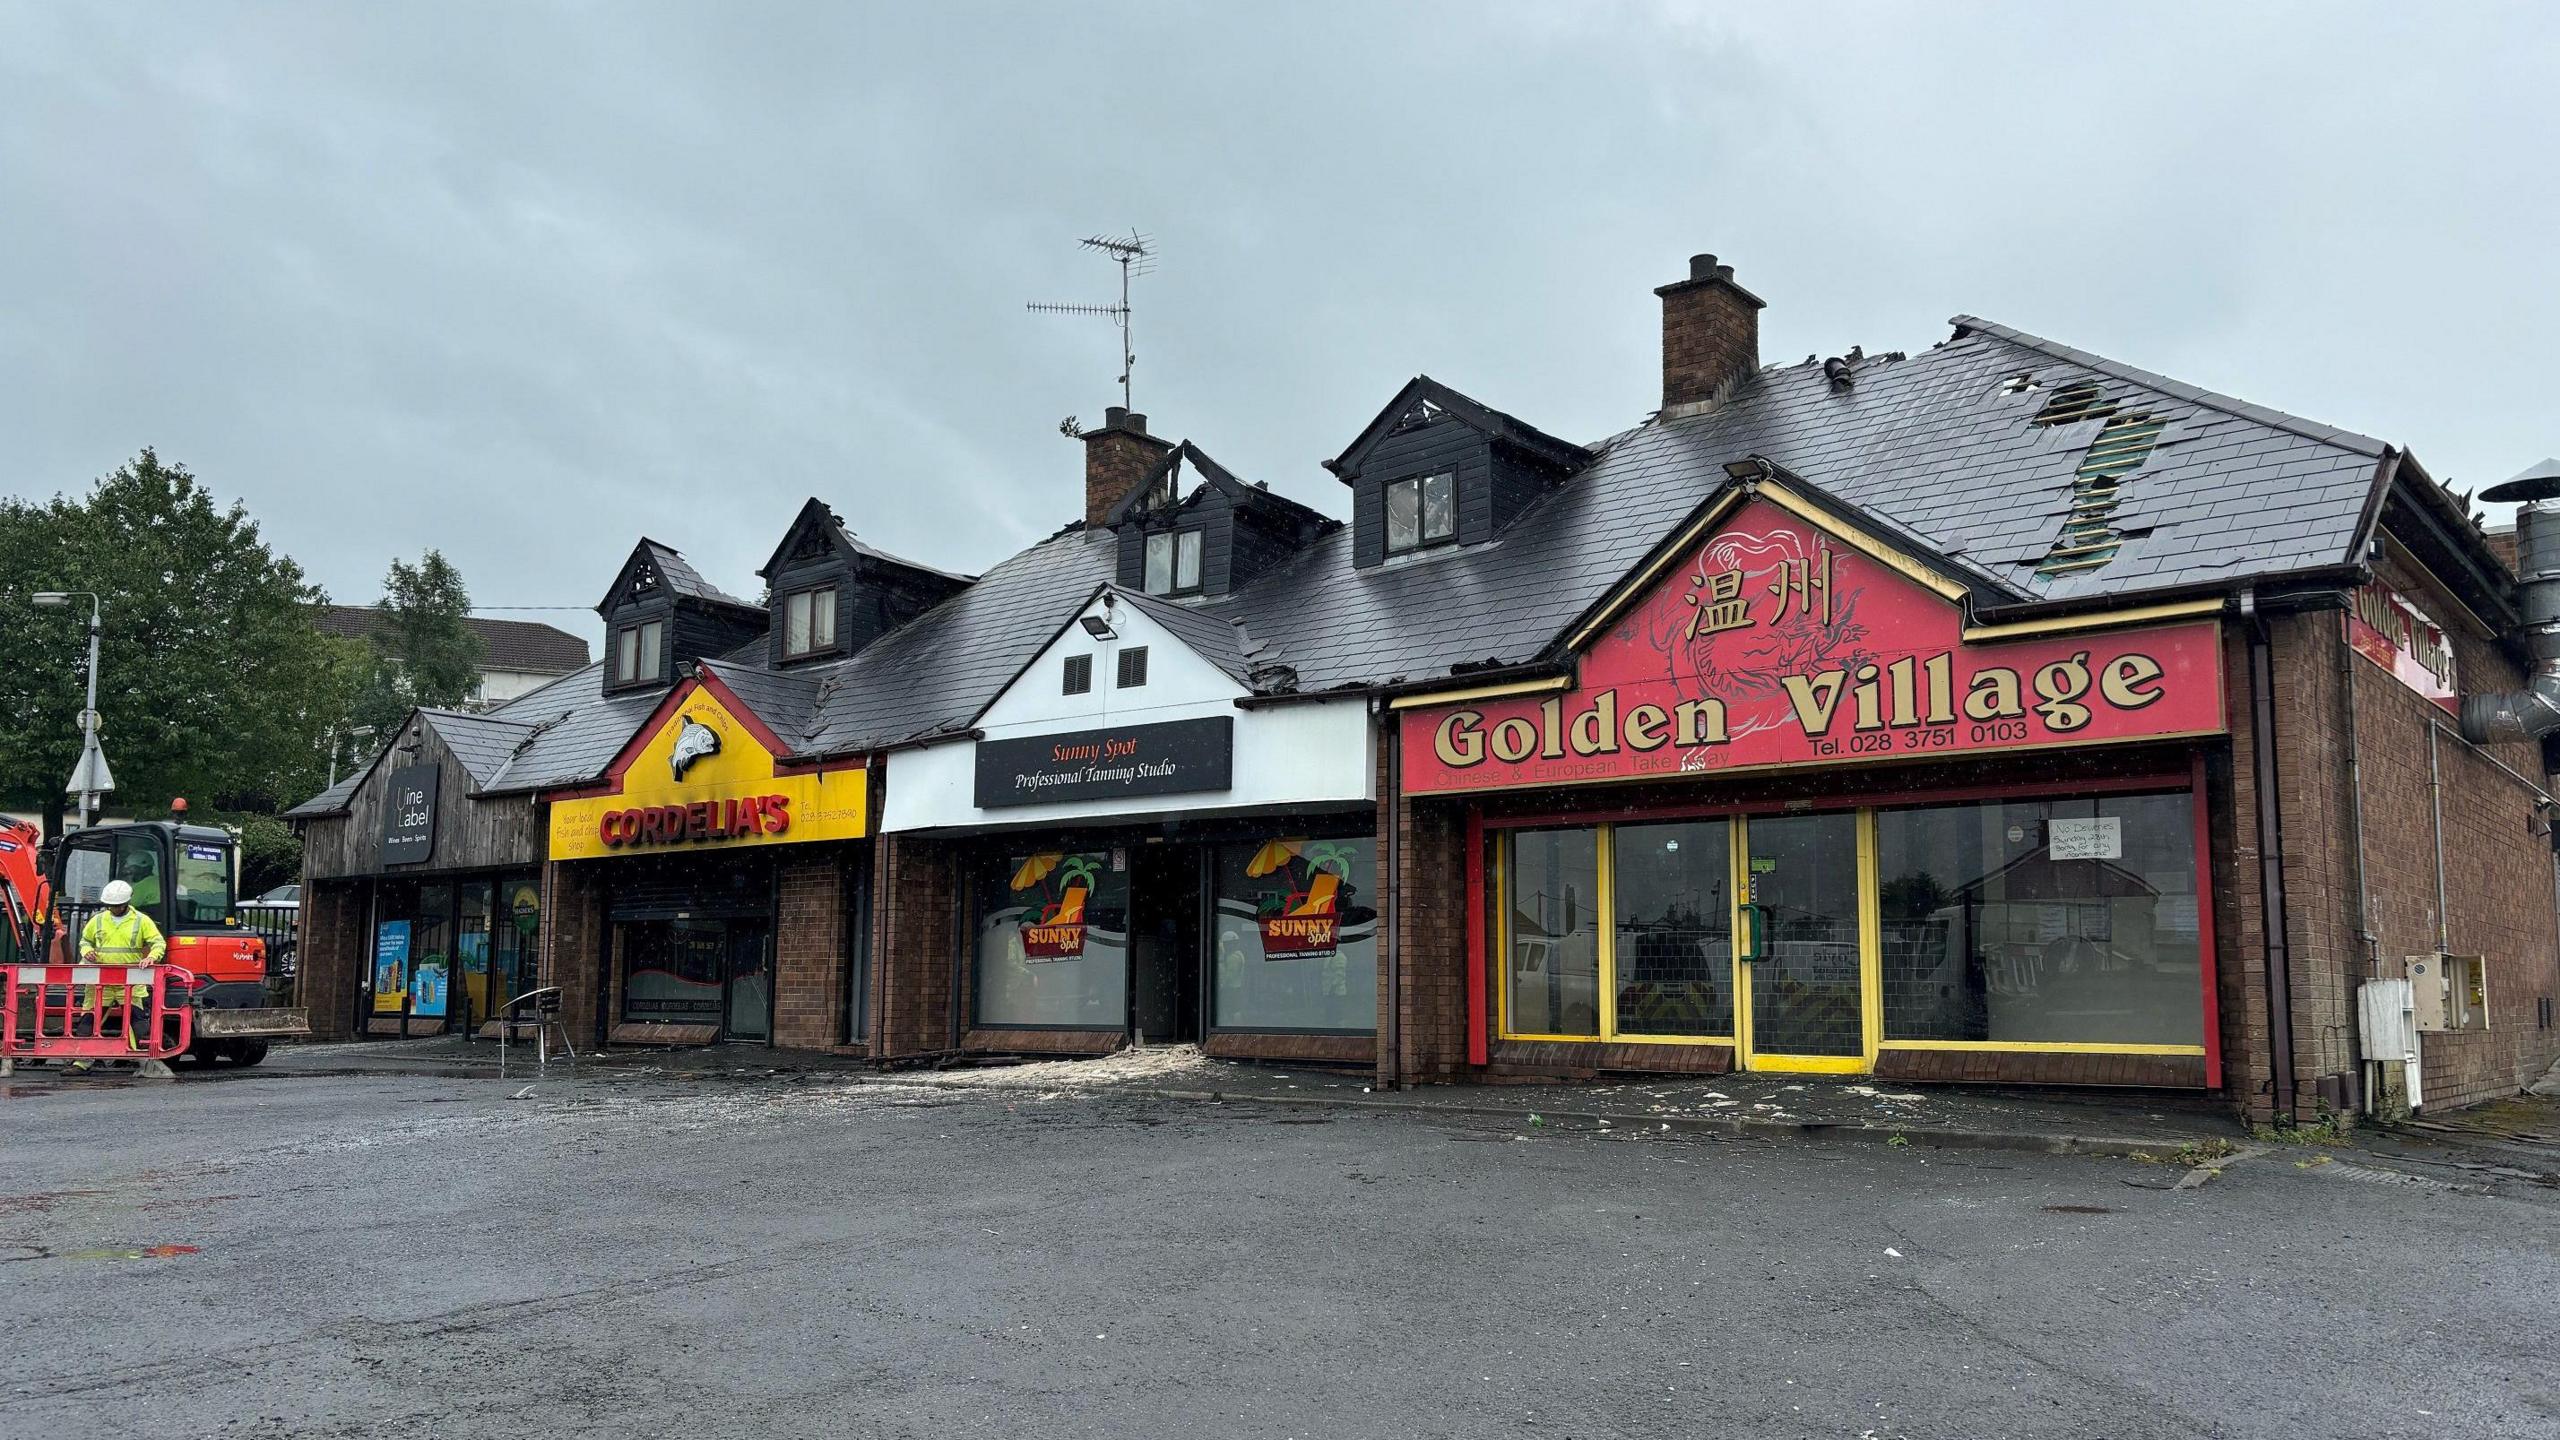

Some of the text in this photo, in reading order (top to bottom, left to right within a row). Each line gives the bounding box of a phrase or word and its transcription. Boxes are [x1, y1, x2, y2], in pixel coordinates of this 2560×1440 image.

[1684, 548, 1832, 641] 温州
[694, 703, 705, 711] Fish
[706, 705, 717, 715] and
[716, 711, 729, 732] Chips
[1434, 651, 2165, 769] Golden Village
[1052, 737, 1139, 764] Sunny Spot
[1809, 722, 2028, 756] Tel. 028 3751 0103
[1015, 758, 1176, 792] Professional Tanning Studio
[1435, 769, 1500, 786] Chinese
[1512, 766, 1524, 781] &
[1534, 759, 1617, 781] European
[1631, 754, 1672, 771] Take
[398, 804, 430, 828] Label
[600, 794, 791, 849] CORDELIA'S
[2056, 824, 2071, 834] No
[1029, 928, 1081, 944] SUNNY
[1269, 919, 1333, 937] SUNNY
[1308, 929, 1331, 947] Spot
[1060, 937, 1079, 953] Spot
